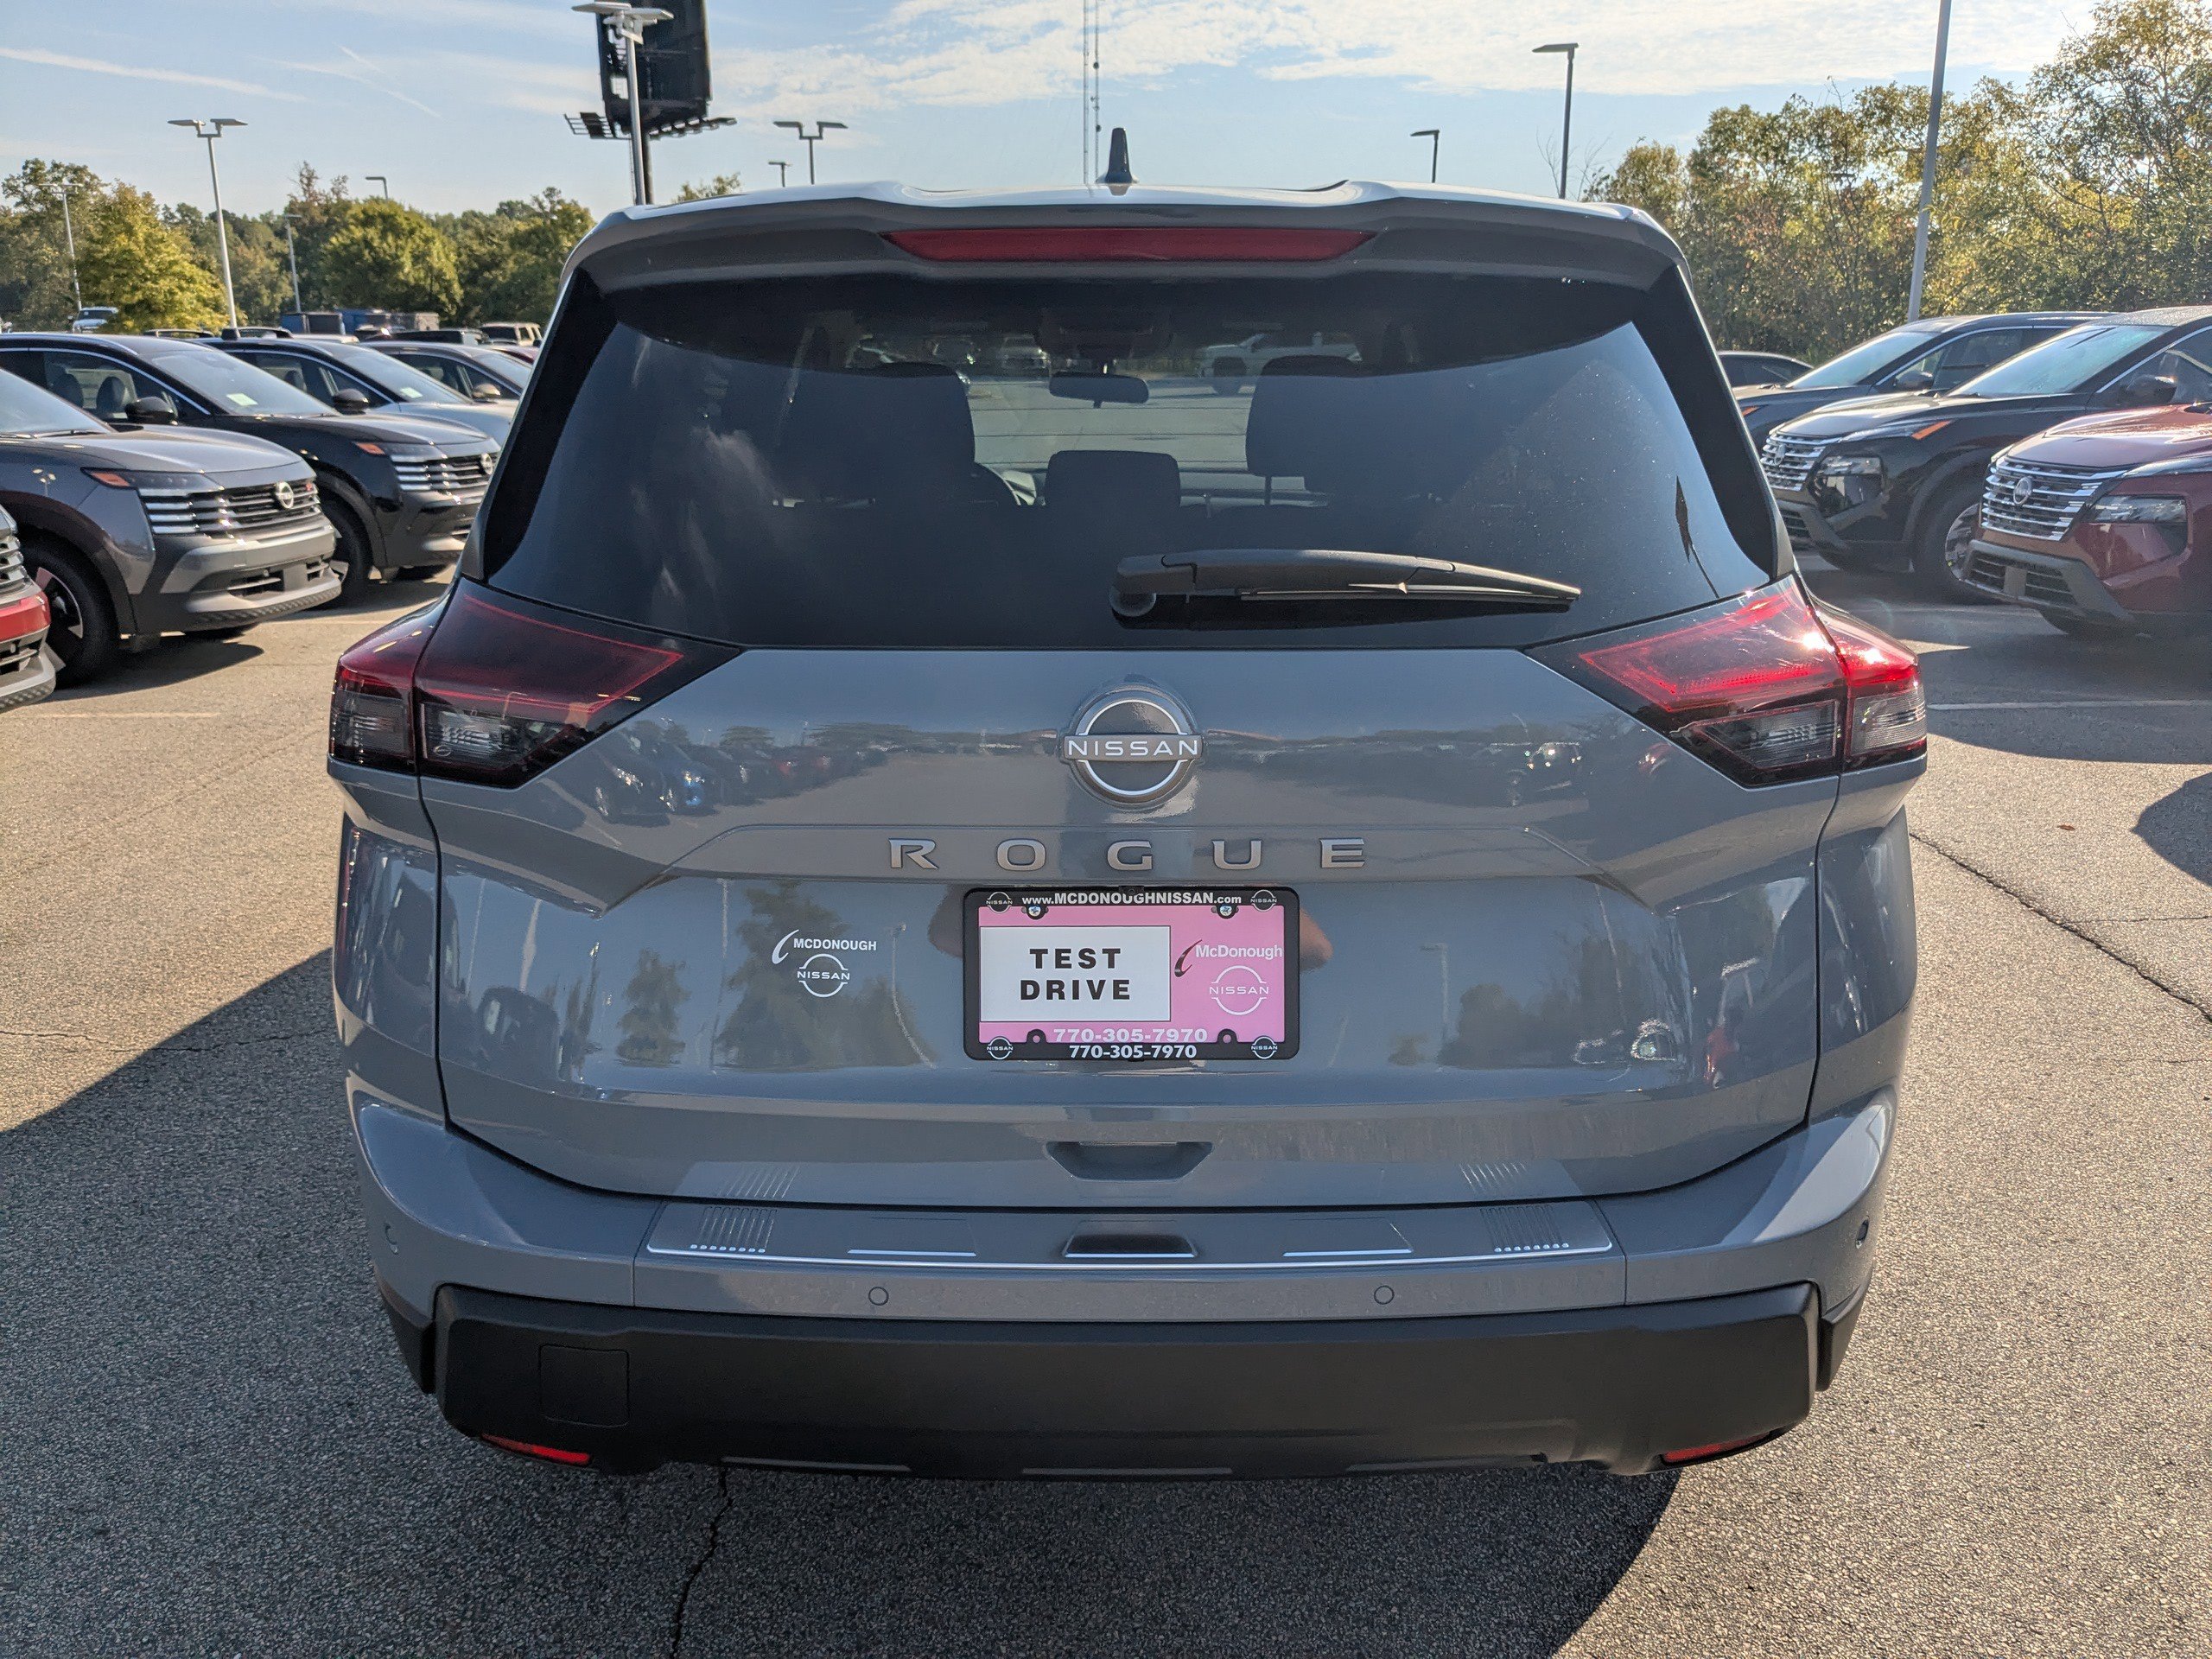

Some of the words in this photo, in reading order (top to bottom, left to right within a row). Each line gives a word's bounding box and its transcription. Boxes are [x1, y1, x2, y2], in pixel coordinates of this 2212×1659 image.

[1068, 740, 1198, 756] NISSAN
[888, 837, 1365, 871] ROGUE
[1022, 892, 1242, 905] www.MCDONOUGHNISSAN.com
[793, 938, 877, 951] MCDONOUGH
[1195, 944, 1283, 960] McDonough
[1029, 948, 1121, 969] TEST
[797, 970, 850, 980] NISSAN
[1020, 979, 1130, 1001] DRIVE
[1210, 986, 1268, 995] NISSAN
[1053, 1028, 1208, 1043] 770-305-7970
[1069, 1045, 1198, 1058] 770-305-7970
